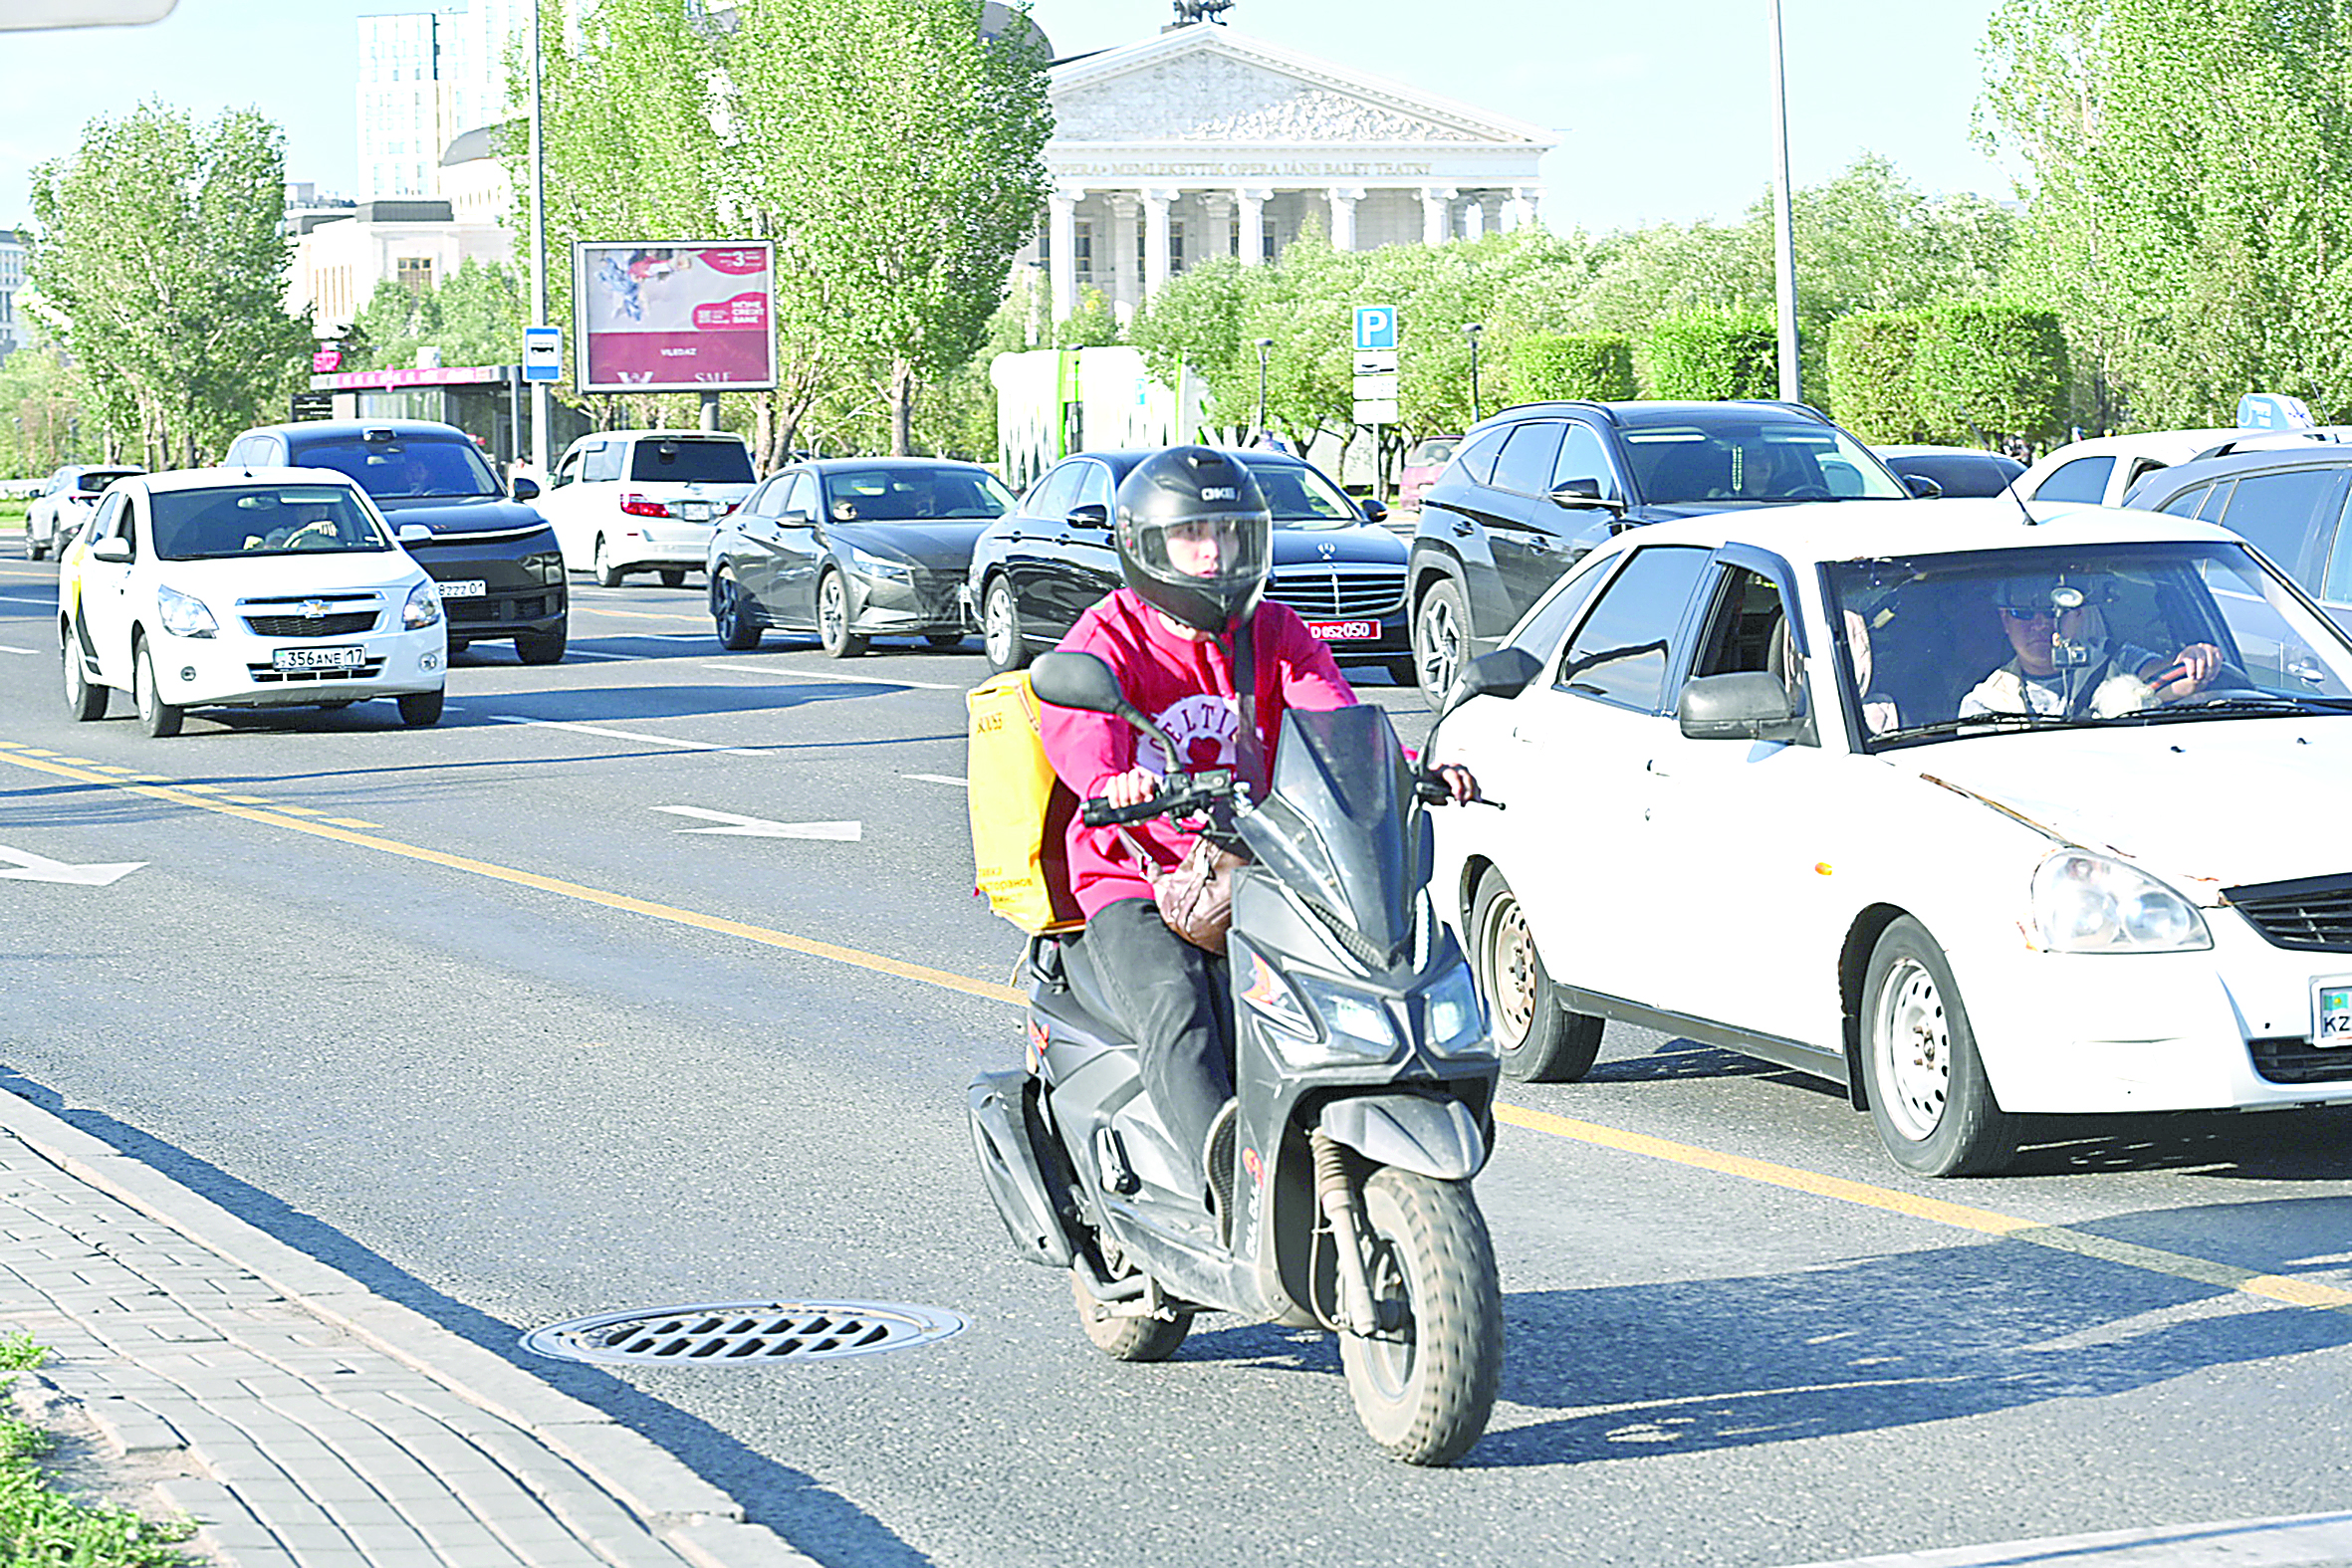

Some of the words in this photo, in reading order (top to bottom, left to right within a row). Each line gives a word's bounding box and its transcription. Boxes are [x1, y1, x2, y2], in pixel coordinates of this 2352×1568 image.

[1228, 162, 1281, 176] OPERA
[1324, 162, 1370, 176] BALET
[1362, 311, 1388, 346] P
[469, 582, 483, 594] 01
[346, 648, 362, 663] 17
[2323, 1015, 2350, 1033] KZ
